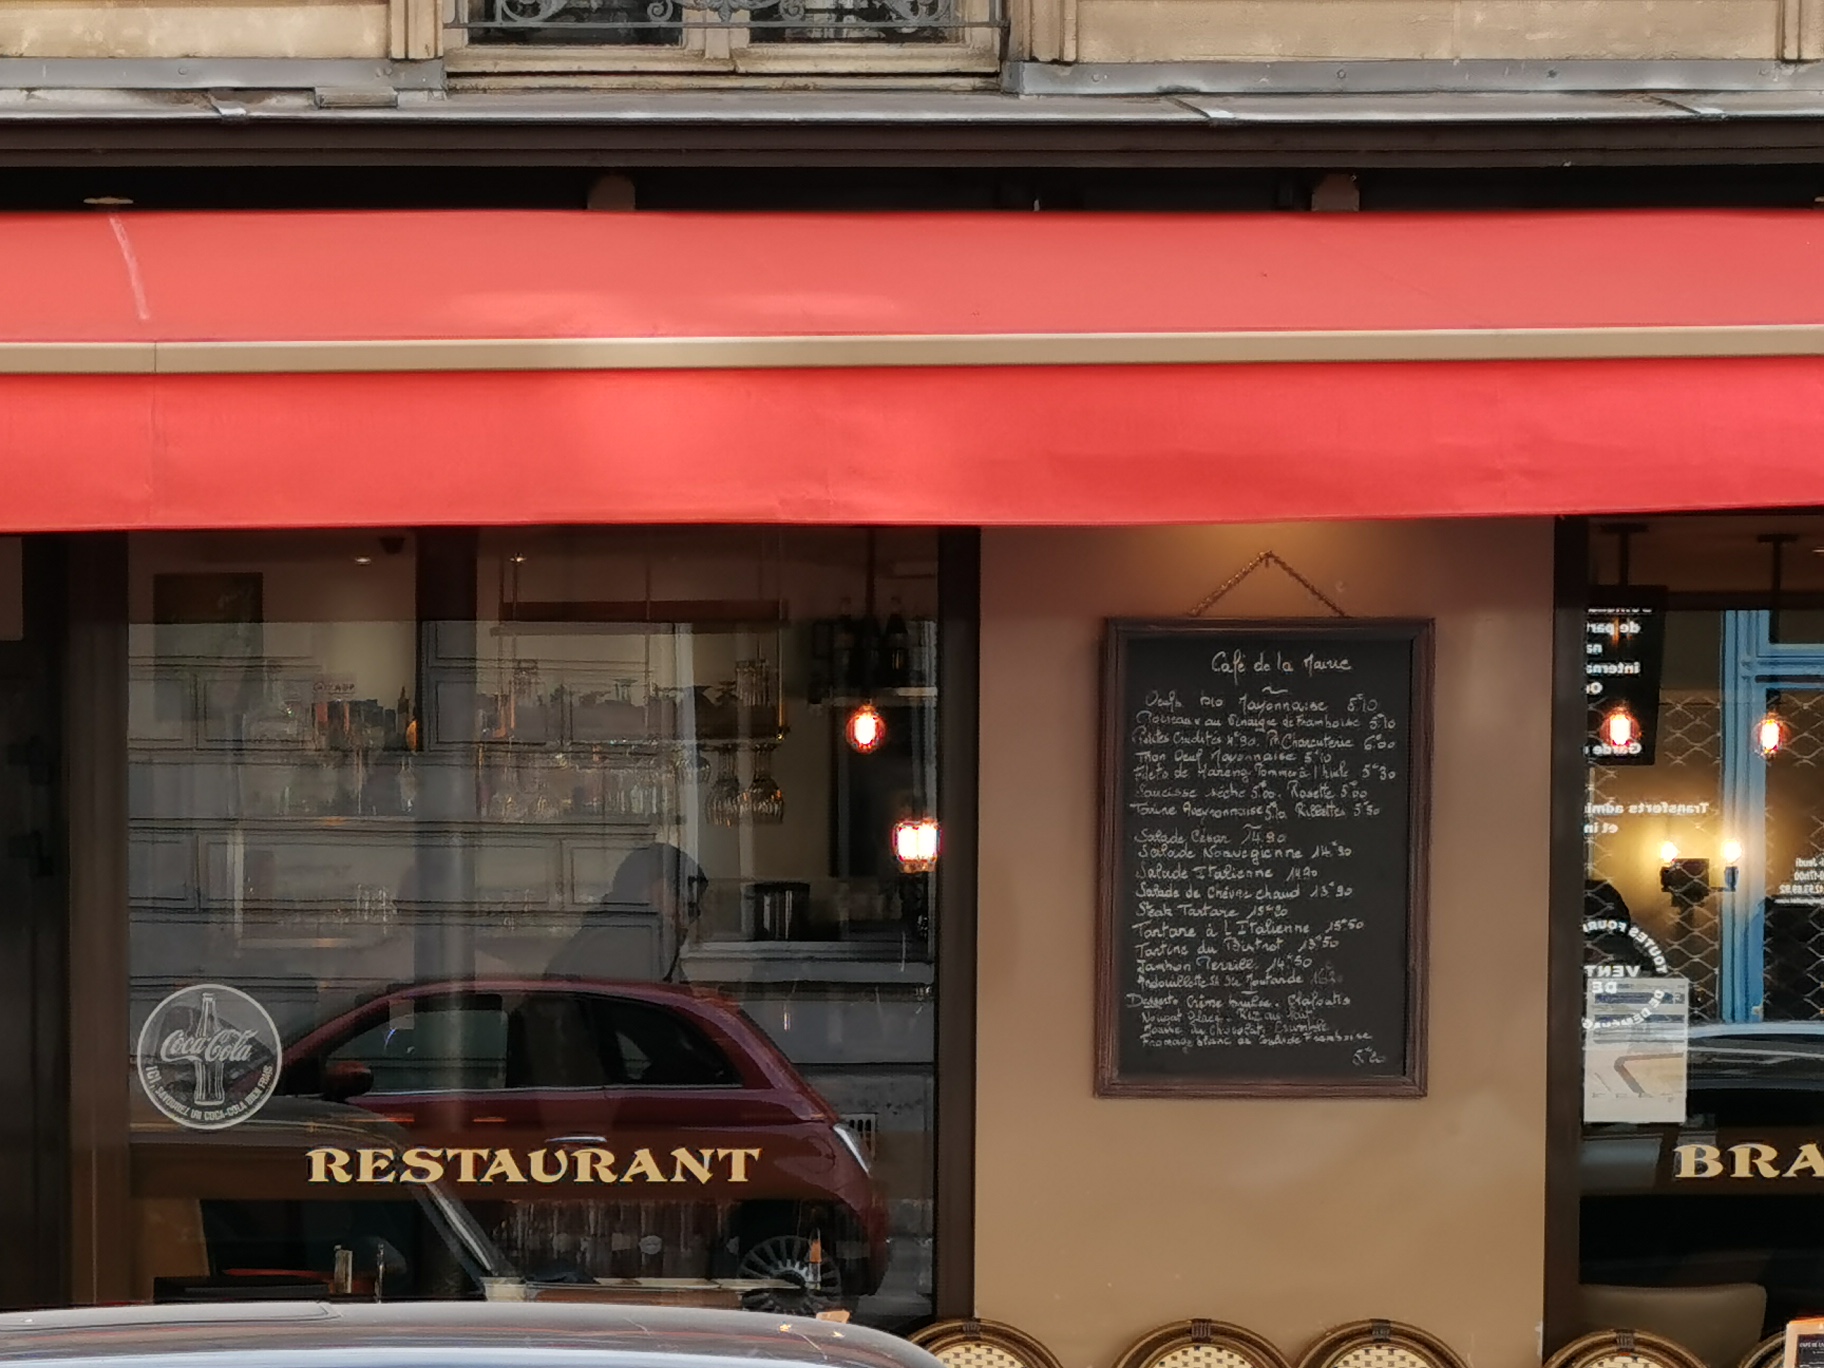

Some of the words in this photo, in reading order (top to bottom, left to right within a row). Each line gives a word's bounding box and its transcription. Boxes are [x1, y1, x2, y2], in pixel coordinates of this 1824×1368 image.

[1253, 651, 1271, 673] de
[1277, 651, 1295, 673] la
[160, 1028, 259, 1063] Coca-Cola
[306, 1146, 762, 1185] RESTAURANT
